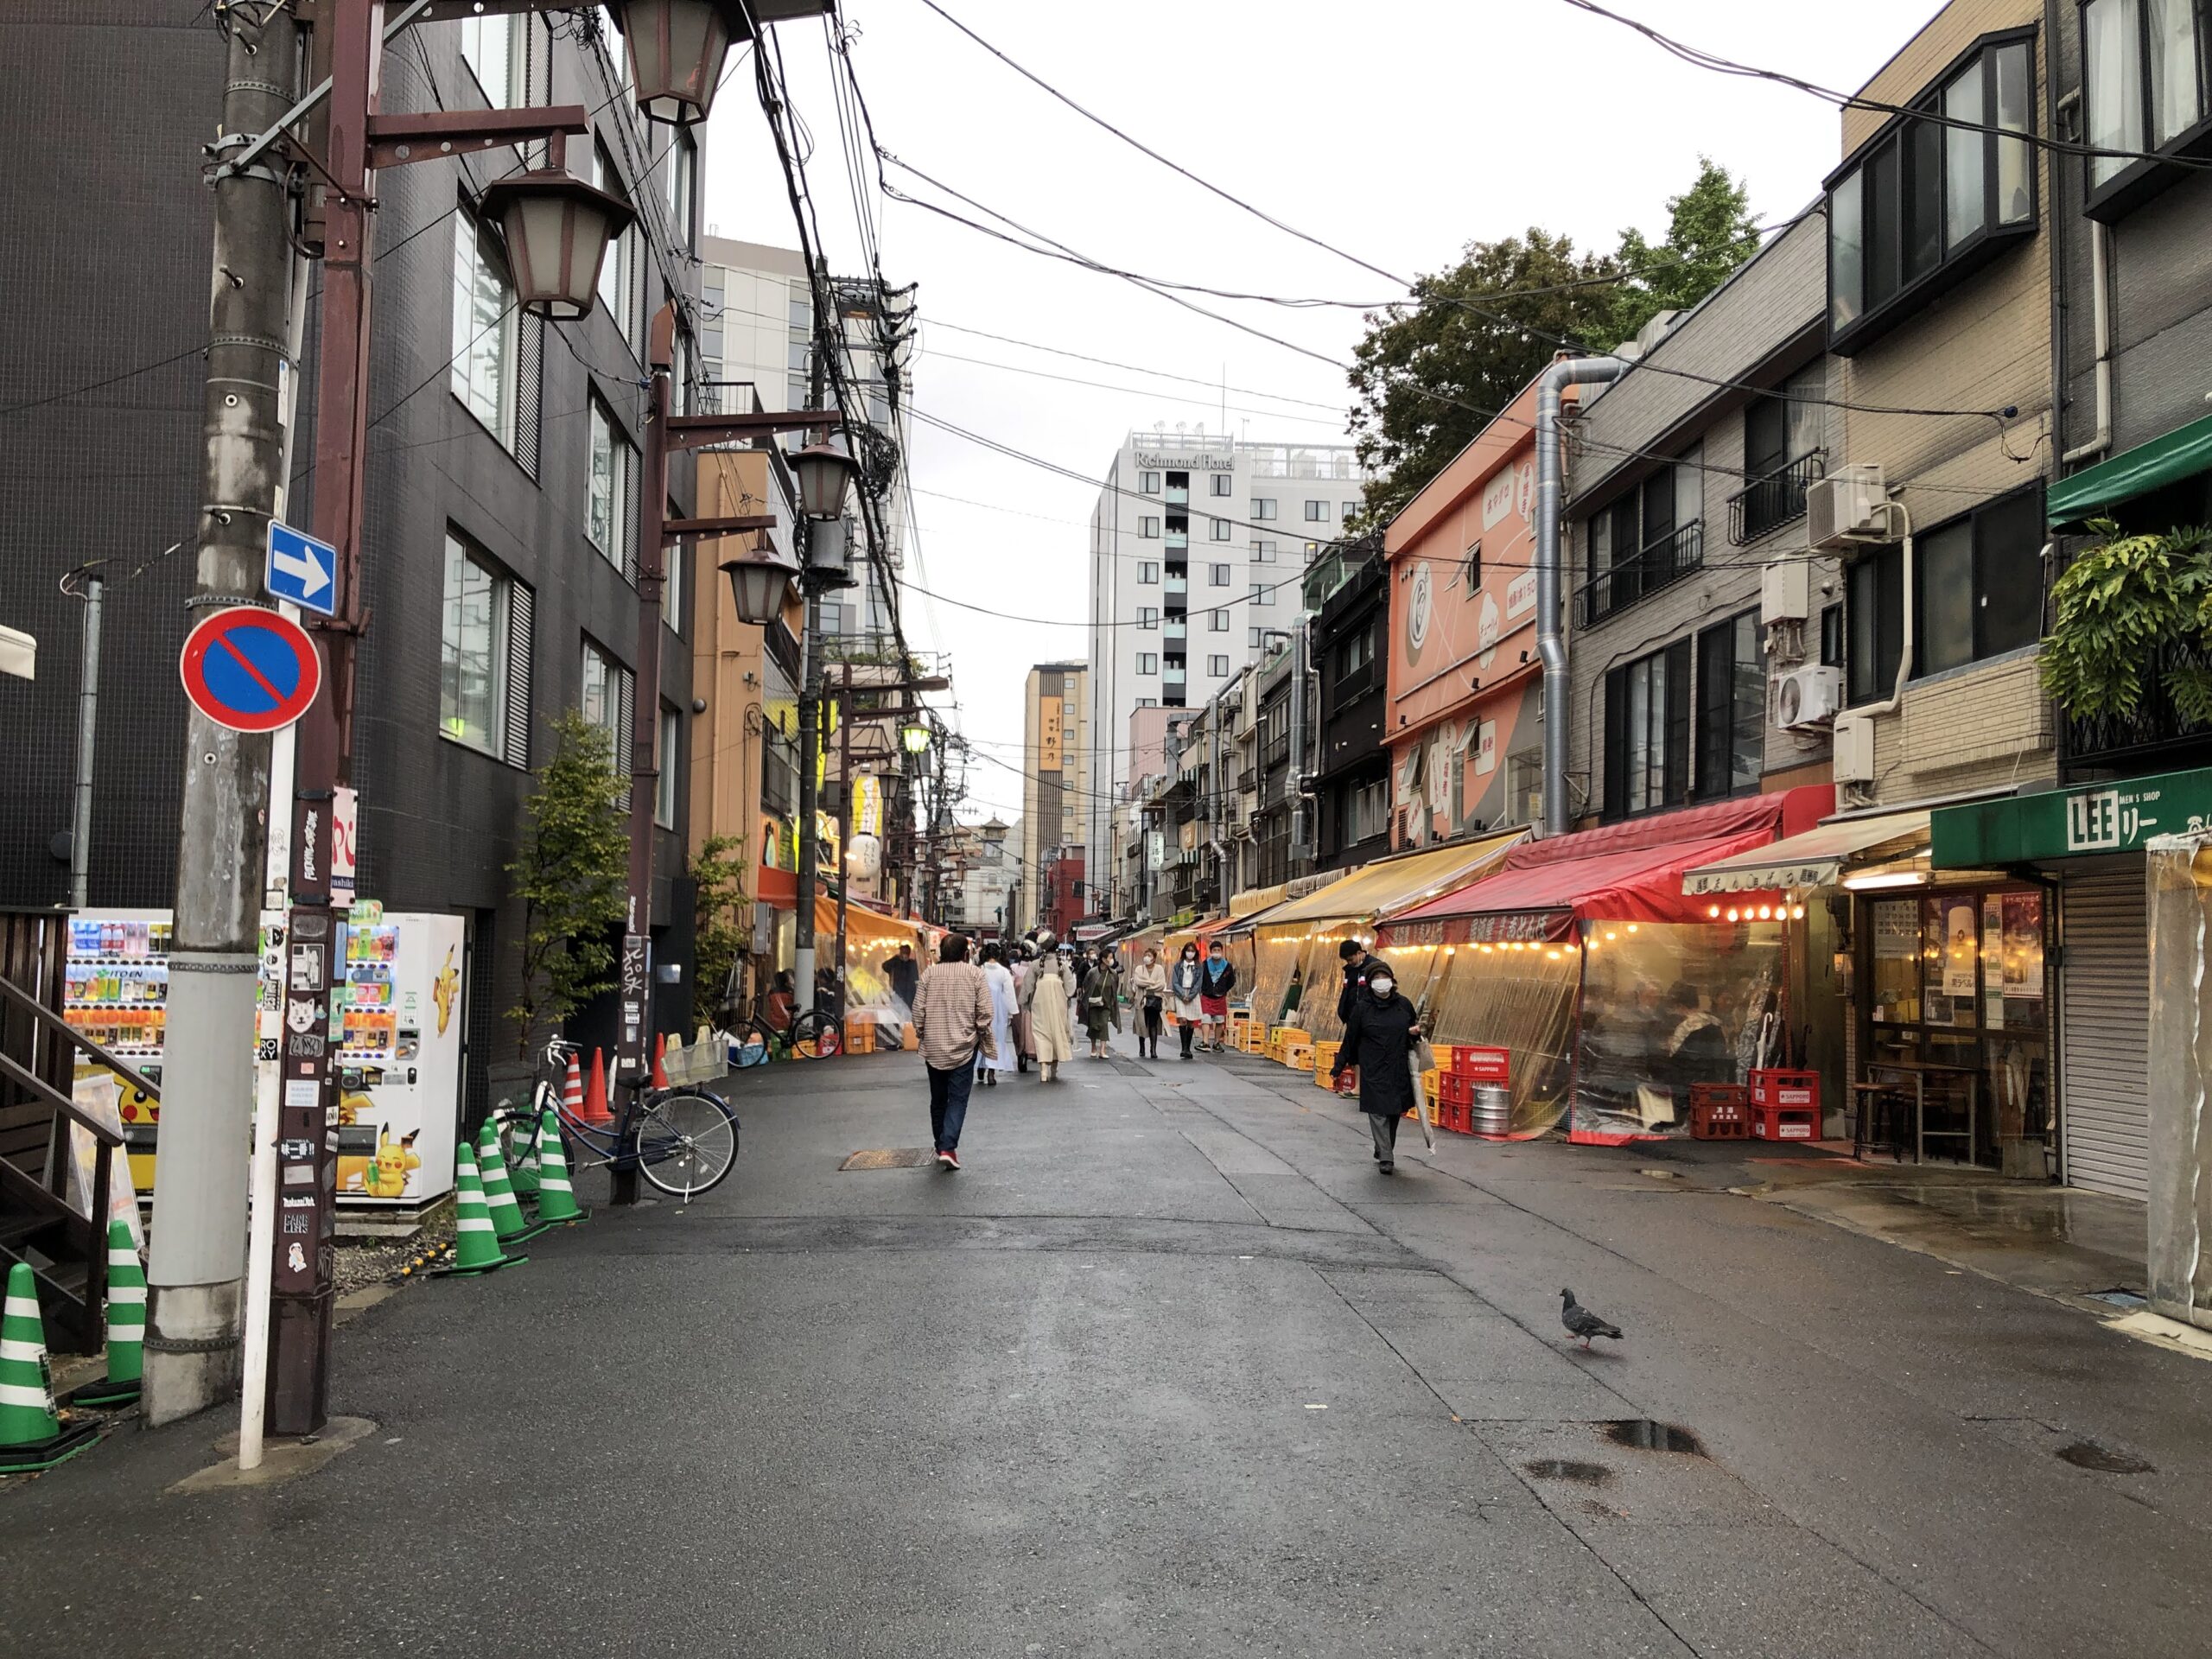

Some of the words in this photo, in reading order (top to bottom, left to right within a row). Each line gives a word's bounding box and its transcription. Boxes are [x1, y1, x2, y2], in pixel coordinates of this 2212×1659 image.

[1135, 452, 1199, 469] Richmond
[1201, 454, 1235, 471] Hotel
[2143, 791, 2161, 802] SHOP
[2072, 797, 2113, 845] LEE
[2122, 807, 2158, 845] リー
